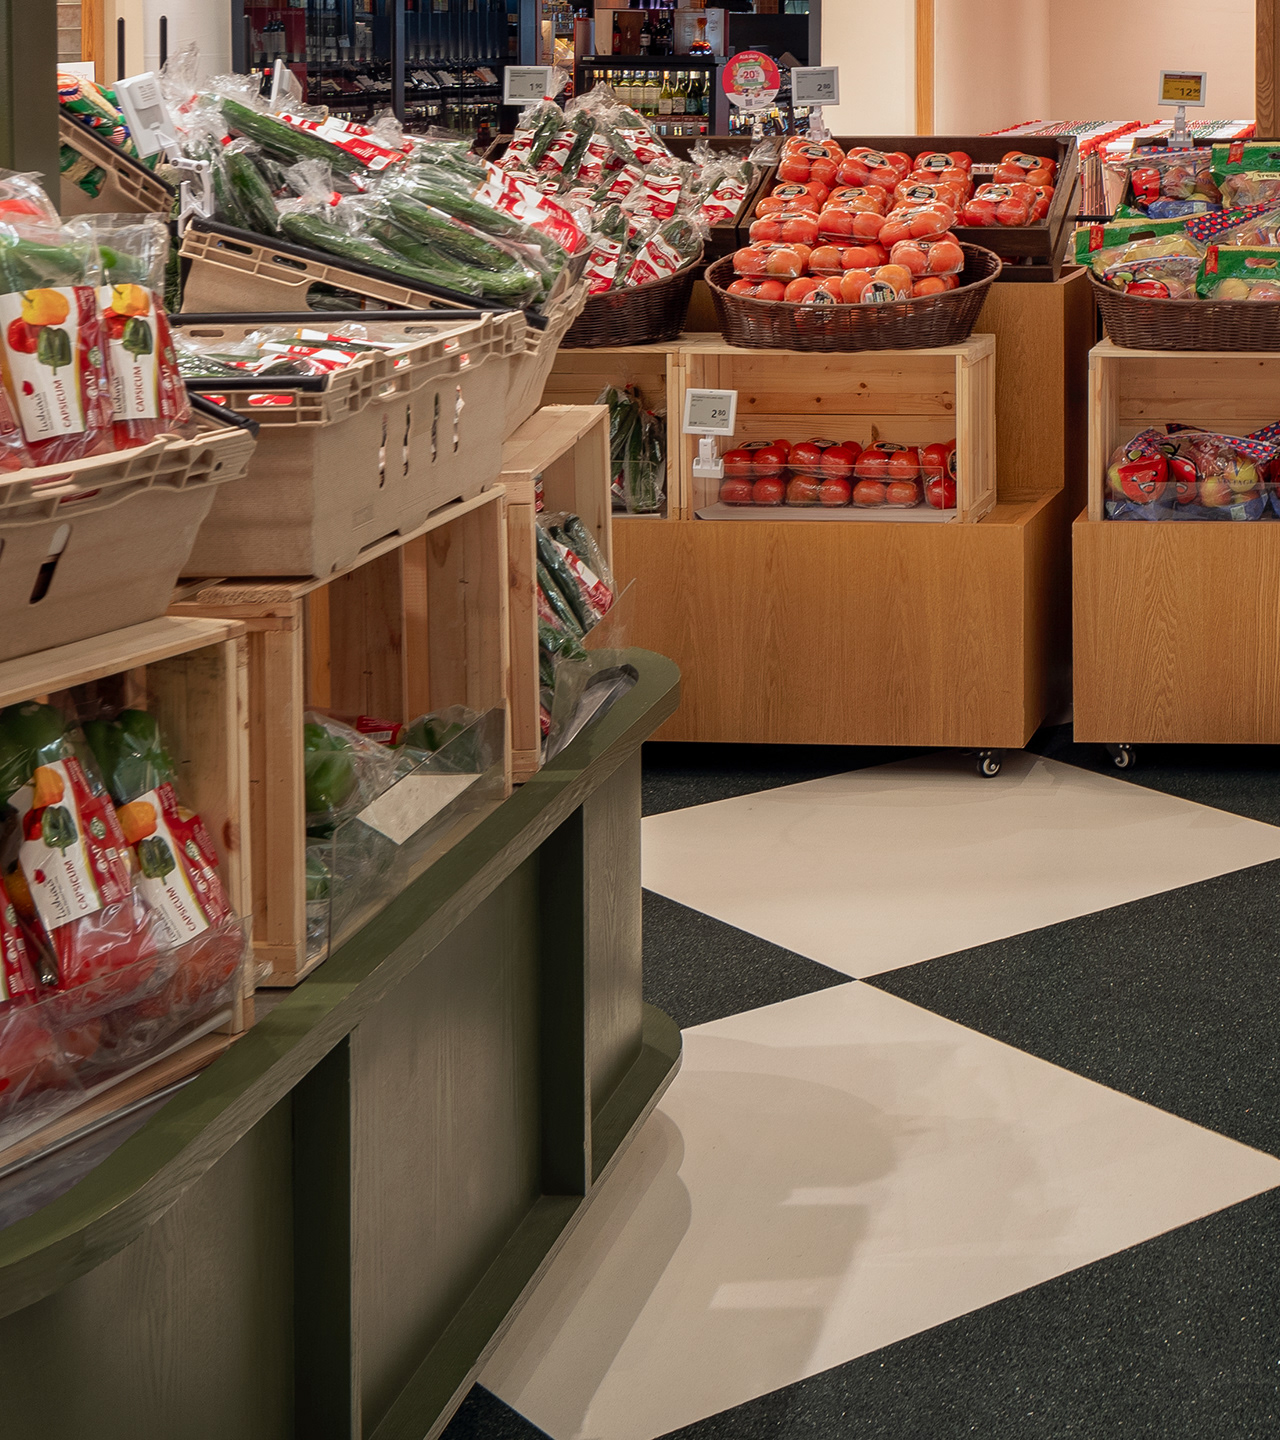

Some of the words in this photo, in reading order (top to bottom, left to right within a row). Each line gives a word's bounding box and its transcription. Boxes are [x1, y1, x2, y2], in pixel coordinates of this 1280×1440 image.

[53, 379, 73, 428] CAPSICUM
[132, 366, 146, 413] CAPSICUM
[63, 859, 89, 910] CAPSICUM
[166, 886, 196, 932] CAPSICUM
